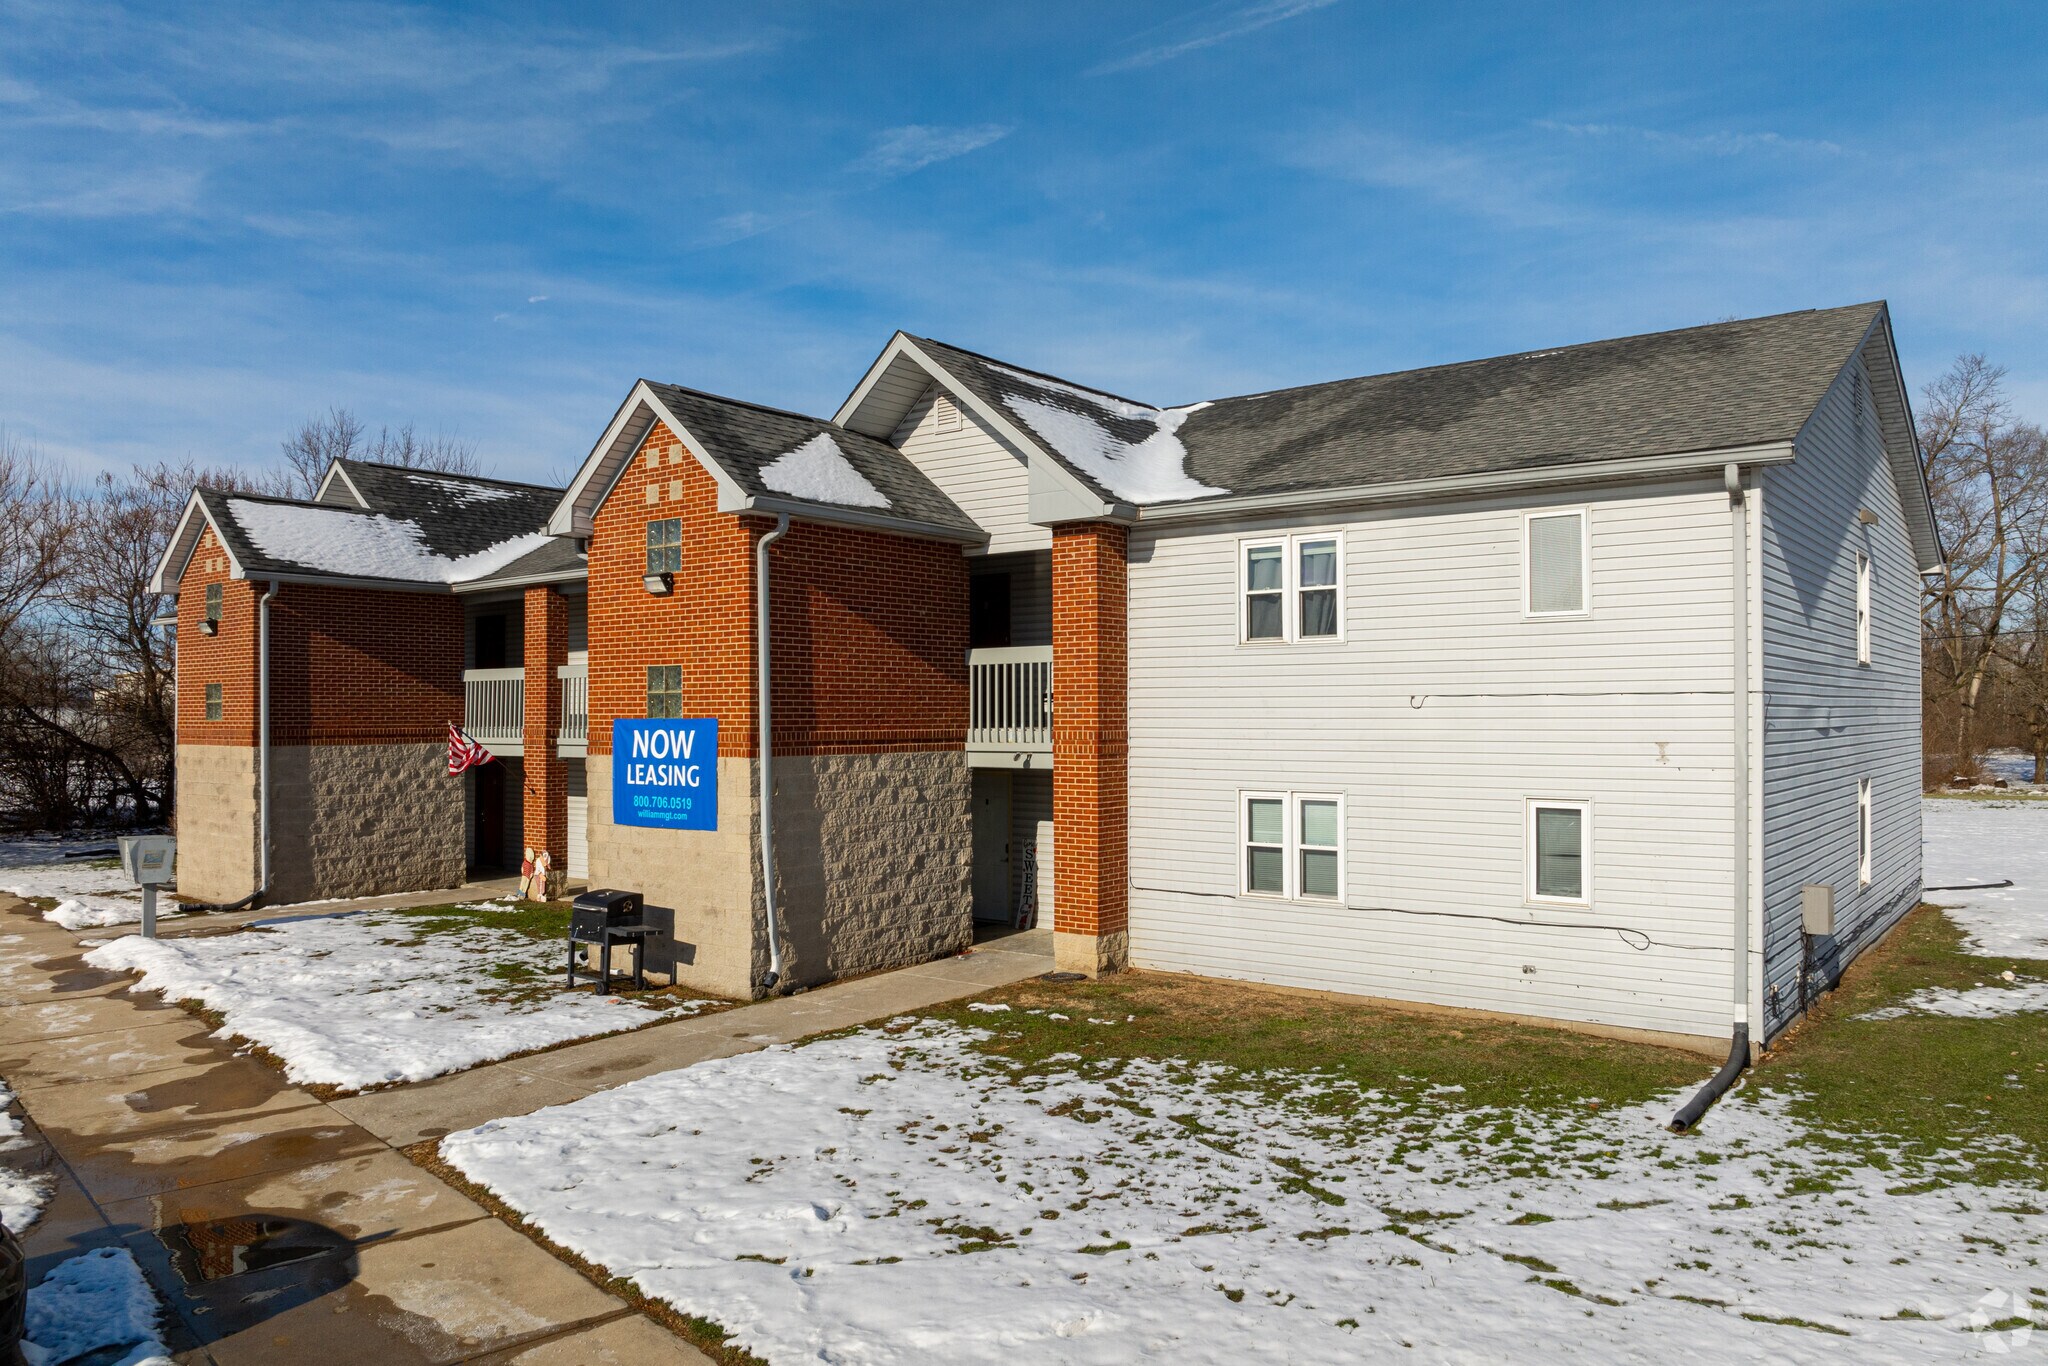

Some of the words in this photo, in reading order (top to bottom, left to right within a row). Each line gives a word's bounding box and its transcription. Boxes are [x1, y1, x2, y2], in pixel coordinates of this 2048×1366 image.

[632, 729, 696, 760] NOW
[626, 763, 700, 788] LEASING
[633, 795, 692, 810] 800.706.0519
[637, 809, 688, 821] williammgt.com
[1022, 848, 1035, 905] SWEET
